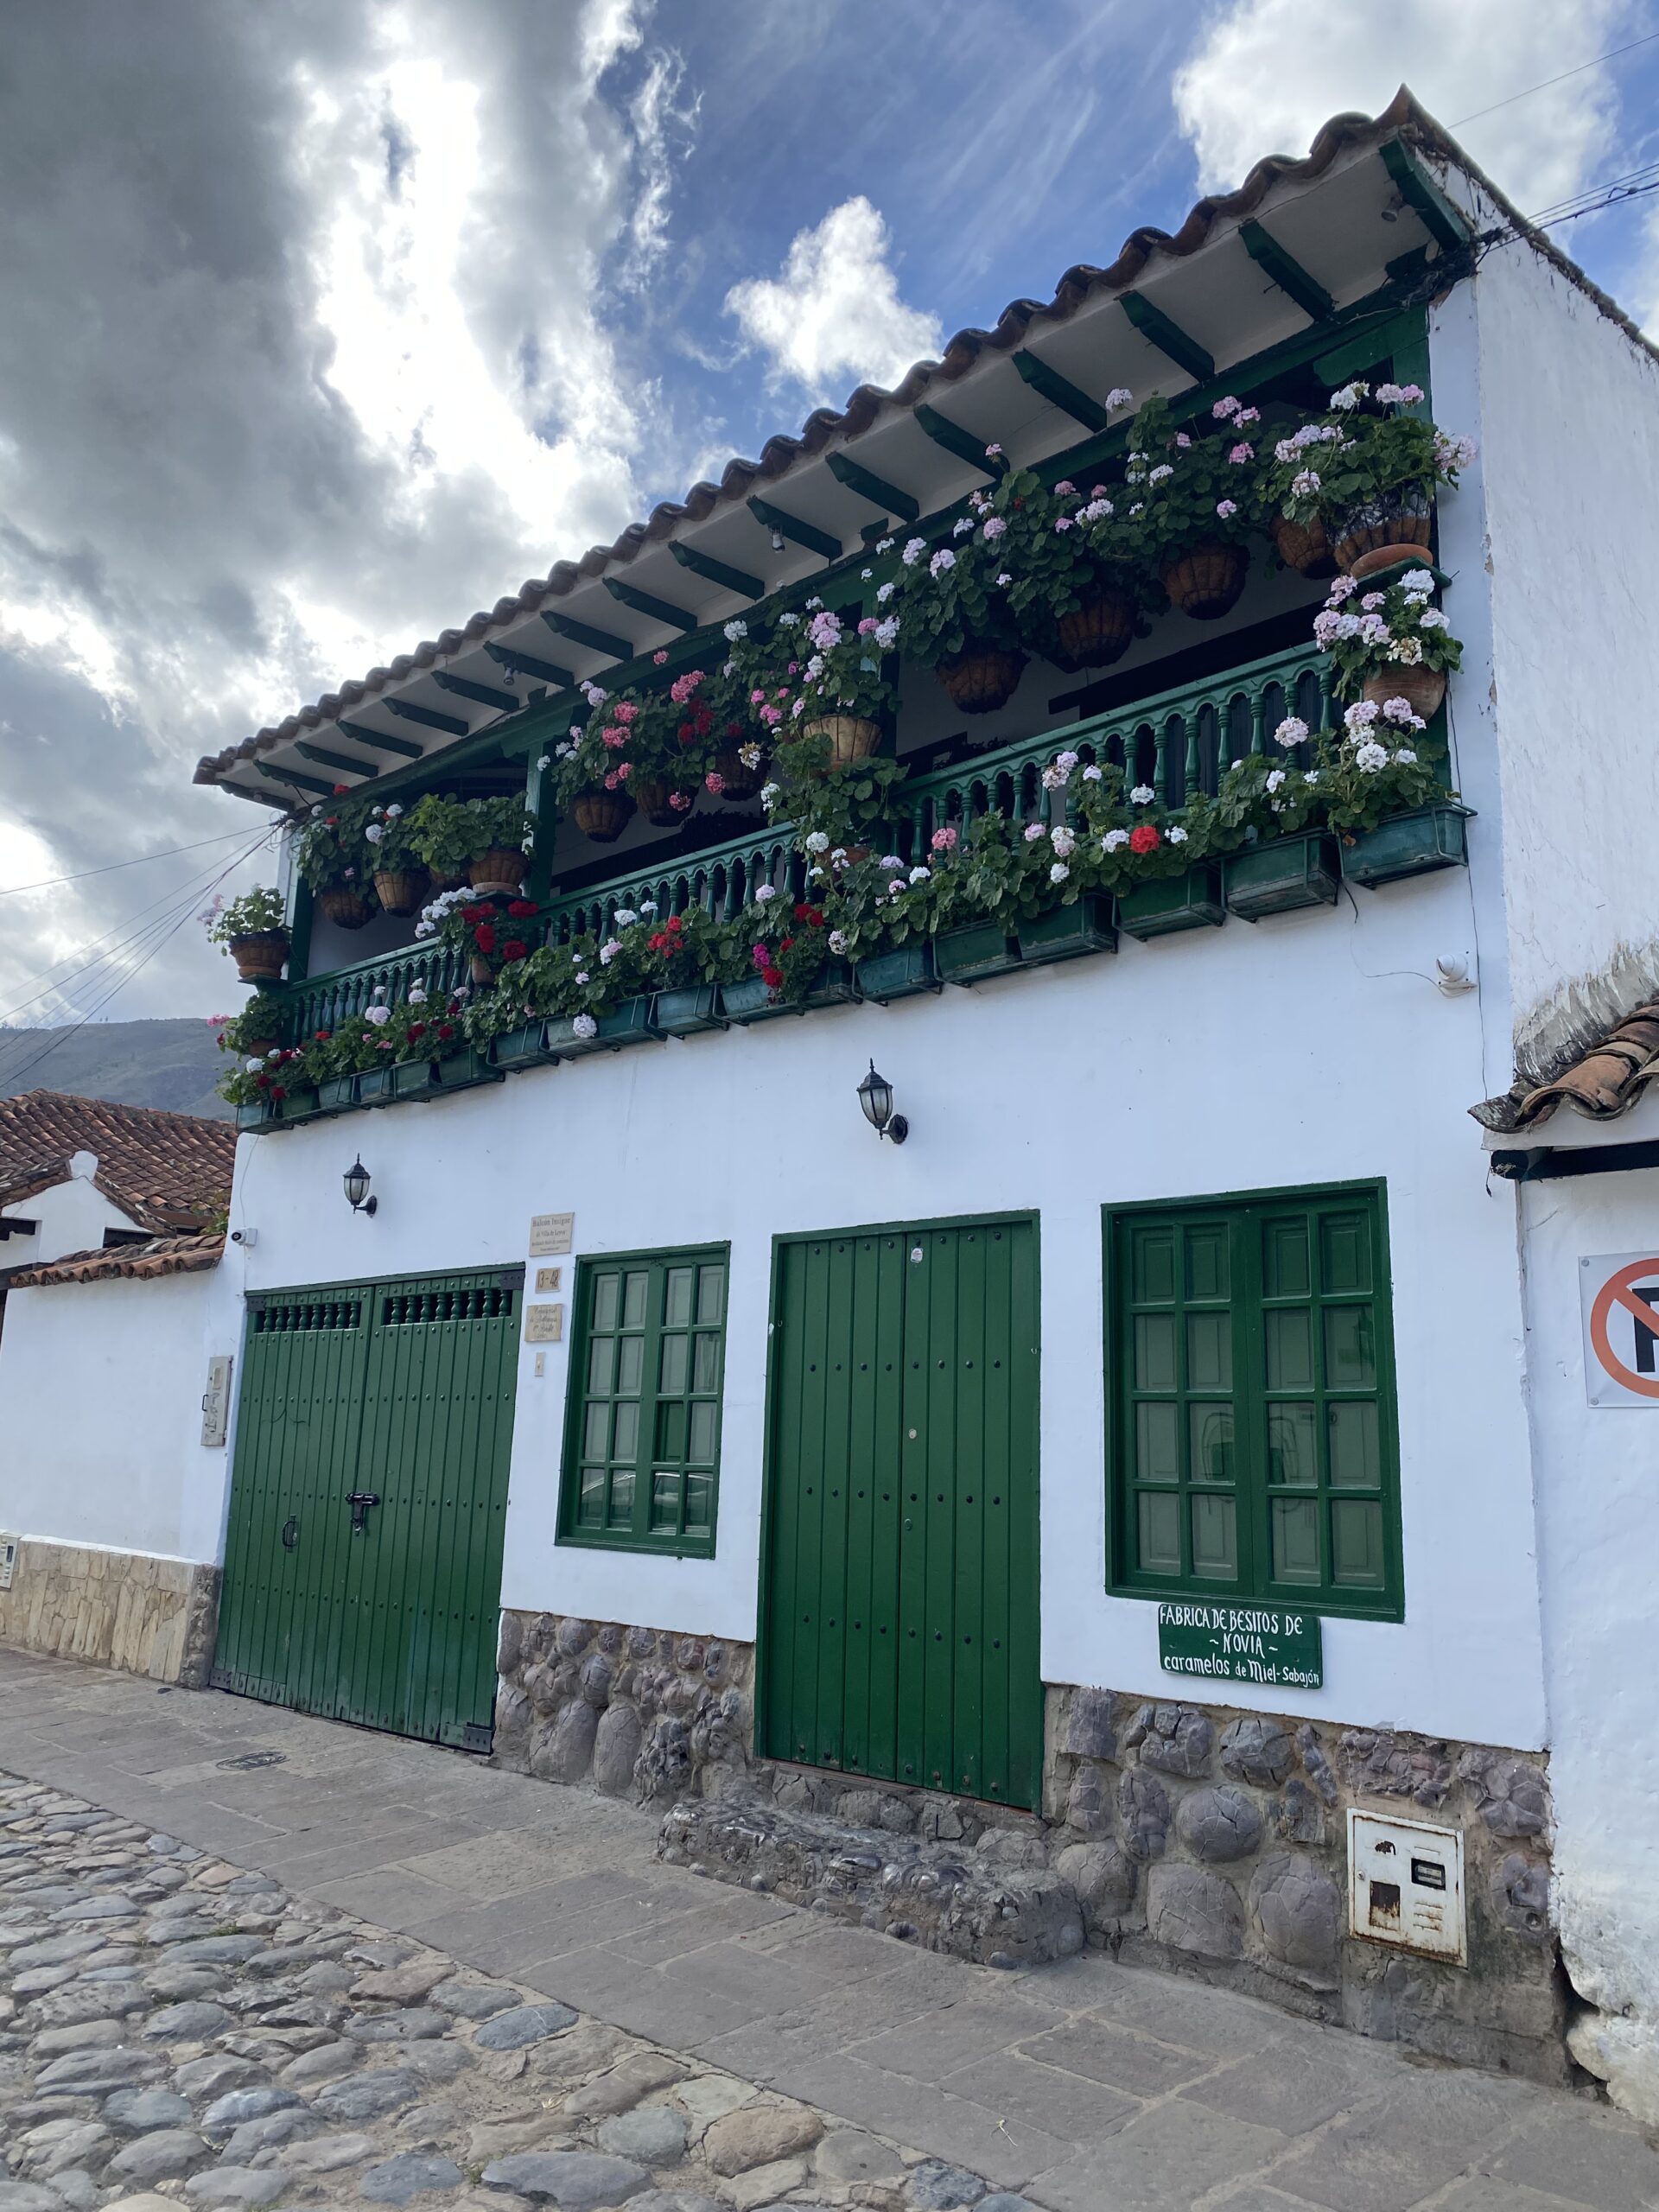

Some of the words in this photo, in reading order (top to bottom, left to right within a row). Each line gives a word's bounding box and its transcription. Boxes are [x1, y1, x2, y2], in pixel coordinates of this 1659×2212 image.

[1160, 1605, 1211, 1629] FABRICA
[1211, 1608, 1228, 1630] DE
[1229, 1610, 1279, 1634] BESITOS
[1285, 1615, 1303, 1637] DE
[1223, 1632, 1265, 1659] NOVIA
[1164, 1652, 1230, 1675] caramelos
[1235, 1661, 1247, 1676] de
